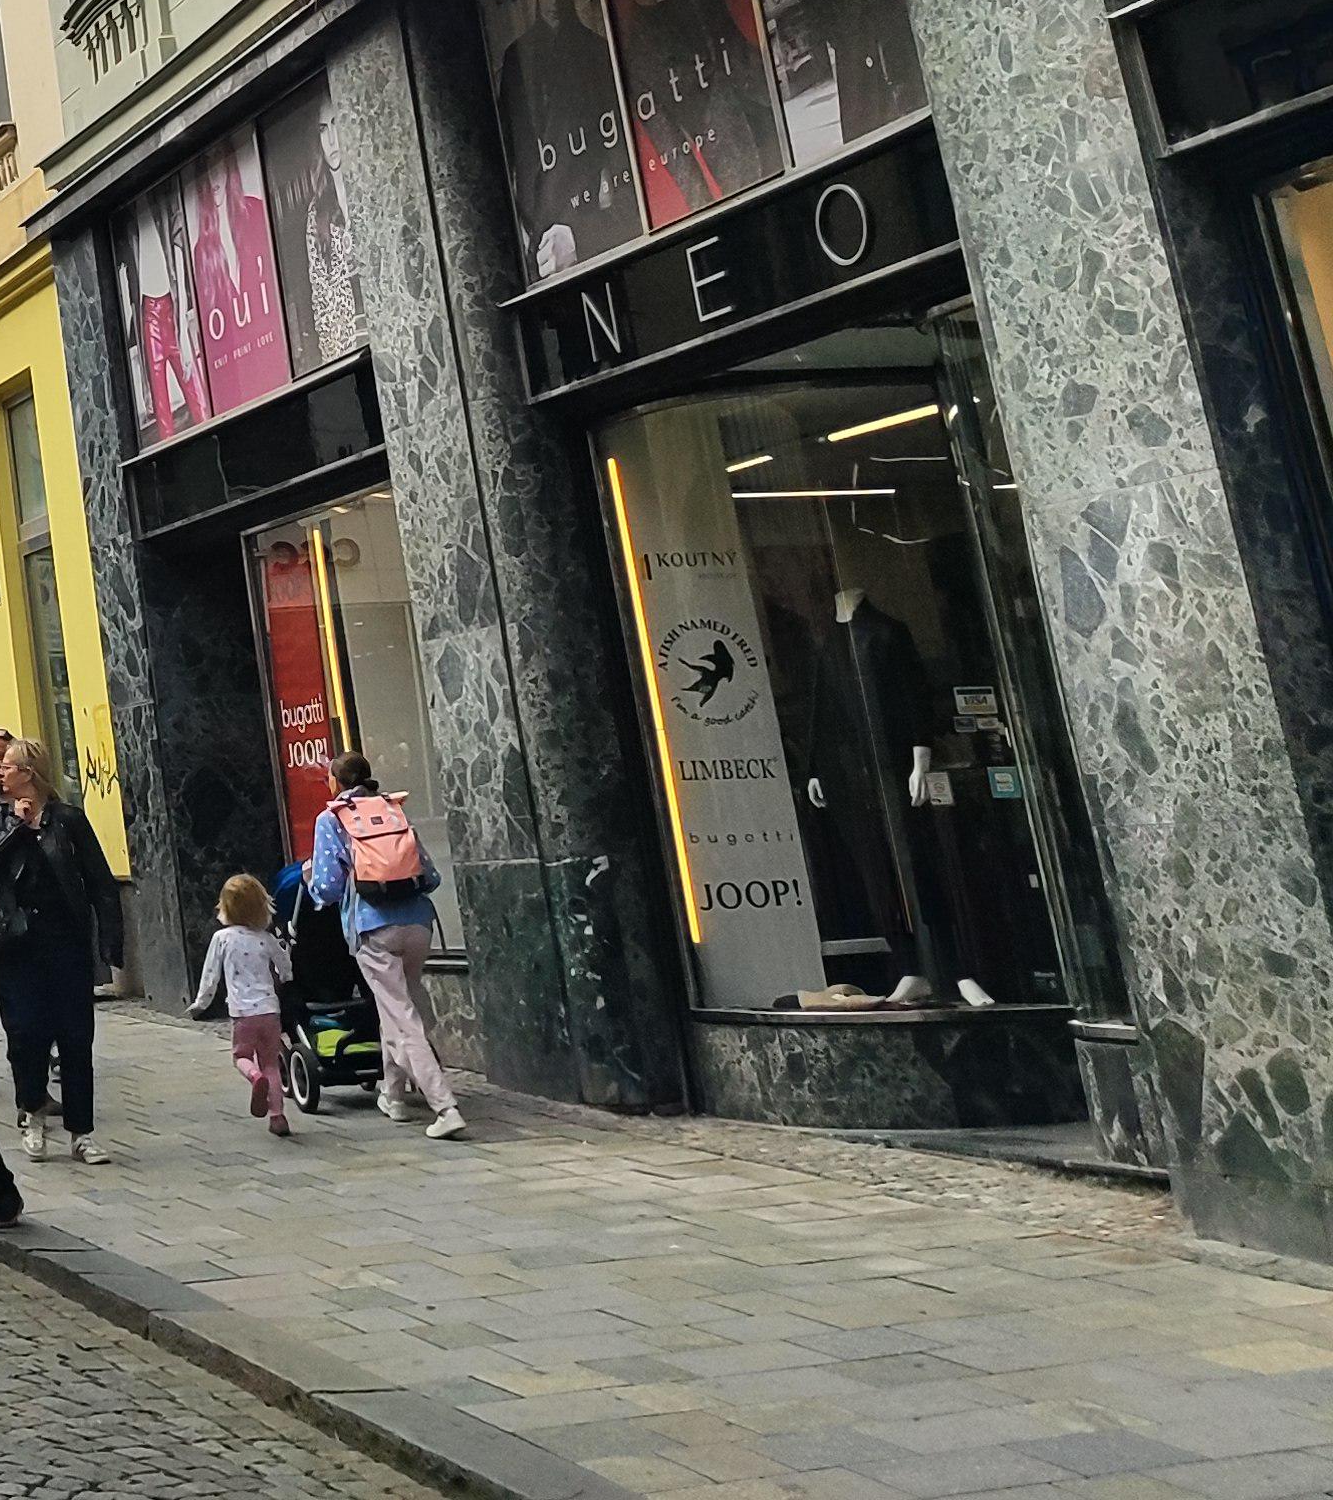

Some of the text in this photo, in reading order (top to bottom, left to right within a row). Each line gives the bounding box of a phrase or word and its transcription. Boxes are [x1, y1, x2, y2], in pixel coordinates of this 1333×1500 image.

[537, 37, 733, 172] bugatti
[569, 125, 718, 210] we are europe
[580, 183, 868, 364] NEO
[257, 332, 274, 348] LOVE
[678, 618, 731, 636] NAMED
[280, 693, 324, 733] bugatti
[704, 714, 733, 727] good
[678, 758, 776, 781] LIMBECK
[689, 829, 794, 846] bugatti
[700, 878, 802, 911] JOOP!
